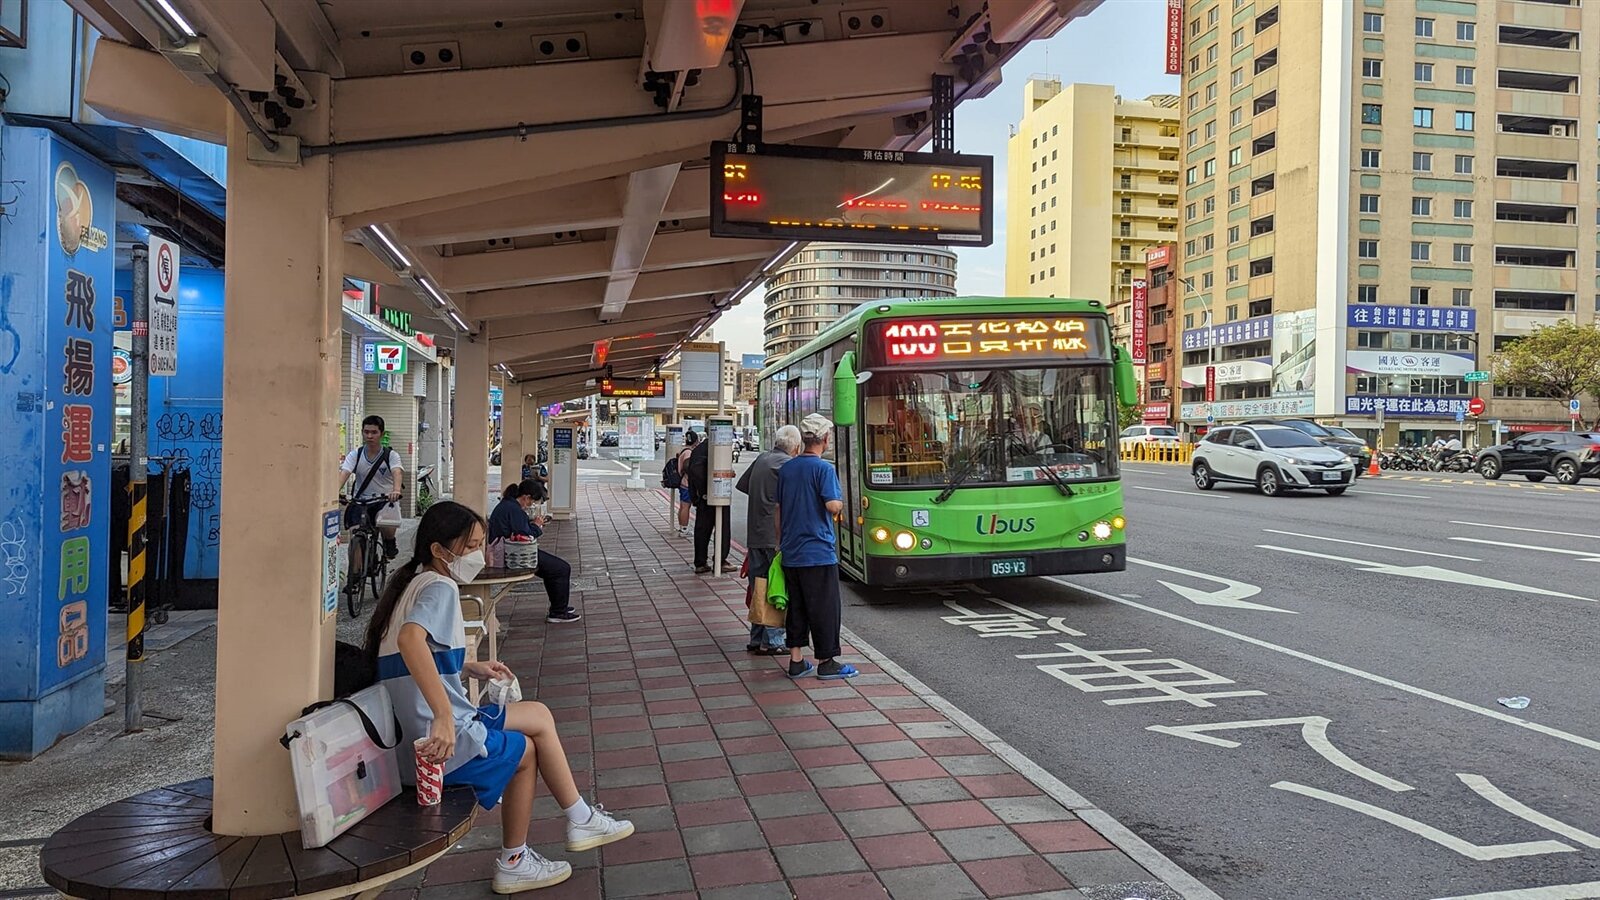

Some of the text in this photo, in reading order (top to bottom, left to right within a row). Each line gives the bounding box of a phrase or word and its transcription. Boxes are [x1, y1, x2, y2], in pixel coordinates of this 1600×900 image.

[863, 150, 905, 162] 預估時間
[1354, 308, 1369, 323] 往
[1373, 307, 1382, 325] 台北
[1388, 307, 1396, 325] 林口
[1446, 309, 1454, 327] 台中
[885, 320, 1088, 355] 100 百貨幹線
[1185, 334, 1195, 348] 往
[1378, 355, 1441, 367] 國光 客運
[57, 269, 95, 668] 飛揚運動用品
[991, 559, 1026, 576] 059-V3
